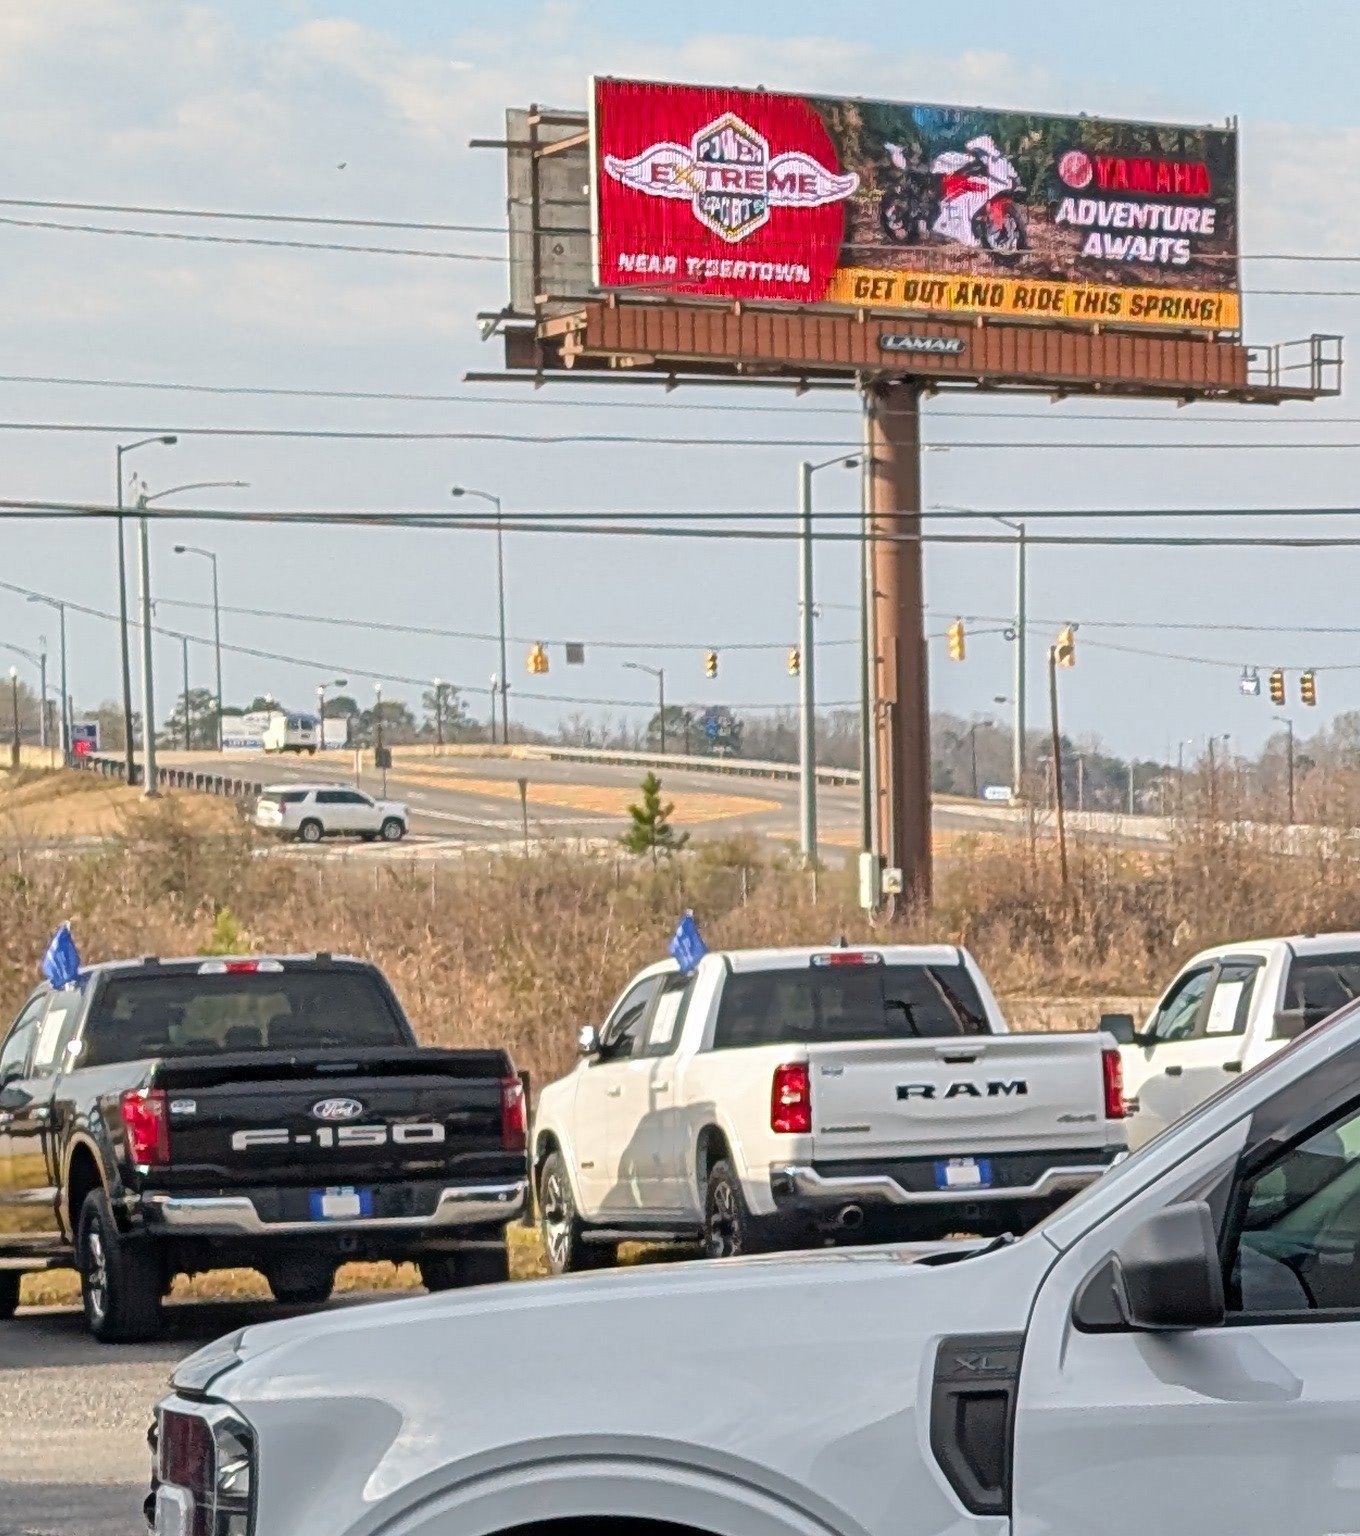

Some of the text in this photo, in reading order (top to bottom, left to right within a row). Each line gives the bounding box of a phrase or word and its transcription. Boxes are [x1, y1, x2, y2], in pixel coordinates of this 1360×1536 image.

[651, 161, 817, 194] EXTREME
[1096, 155, 1212, 197] YAMAHA
[1055, 198, 1217, 235] ADVENTURE
[617, 252, 678, 275] NEAR
[1080, 231, 1191, 265] AWAITS
[854, 276, 1224, 322] GET OUT AND RIDE THIS SPRING!
[886, 335, 962, 352] LAMAR
[896, 1079, 1029, 1101] RAM
[232, 1122, 445, 1151] F-150
